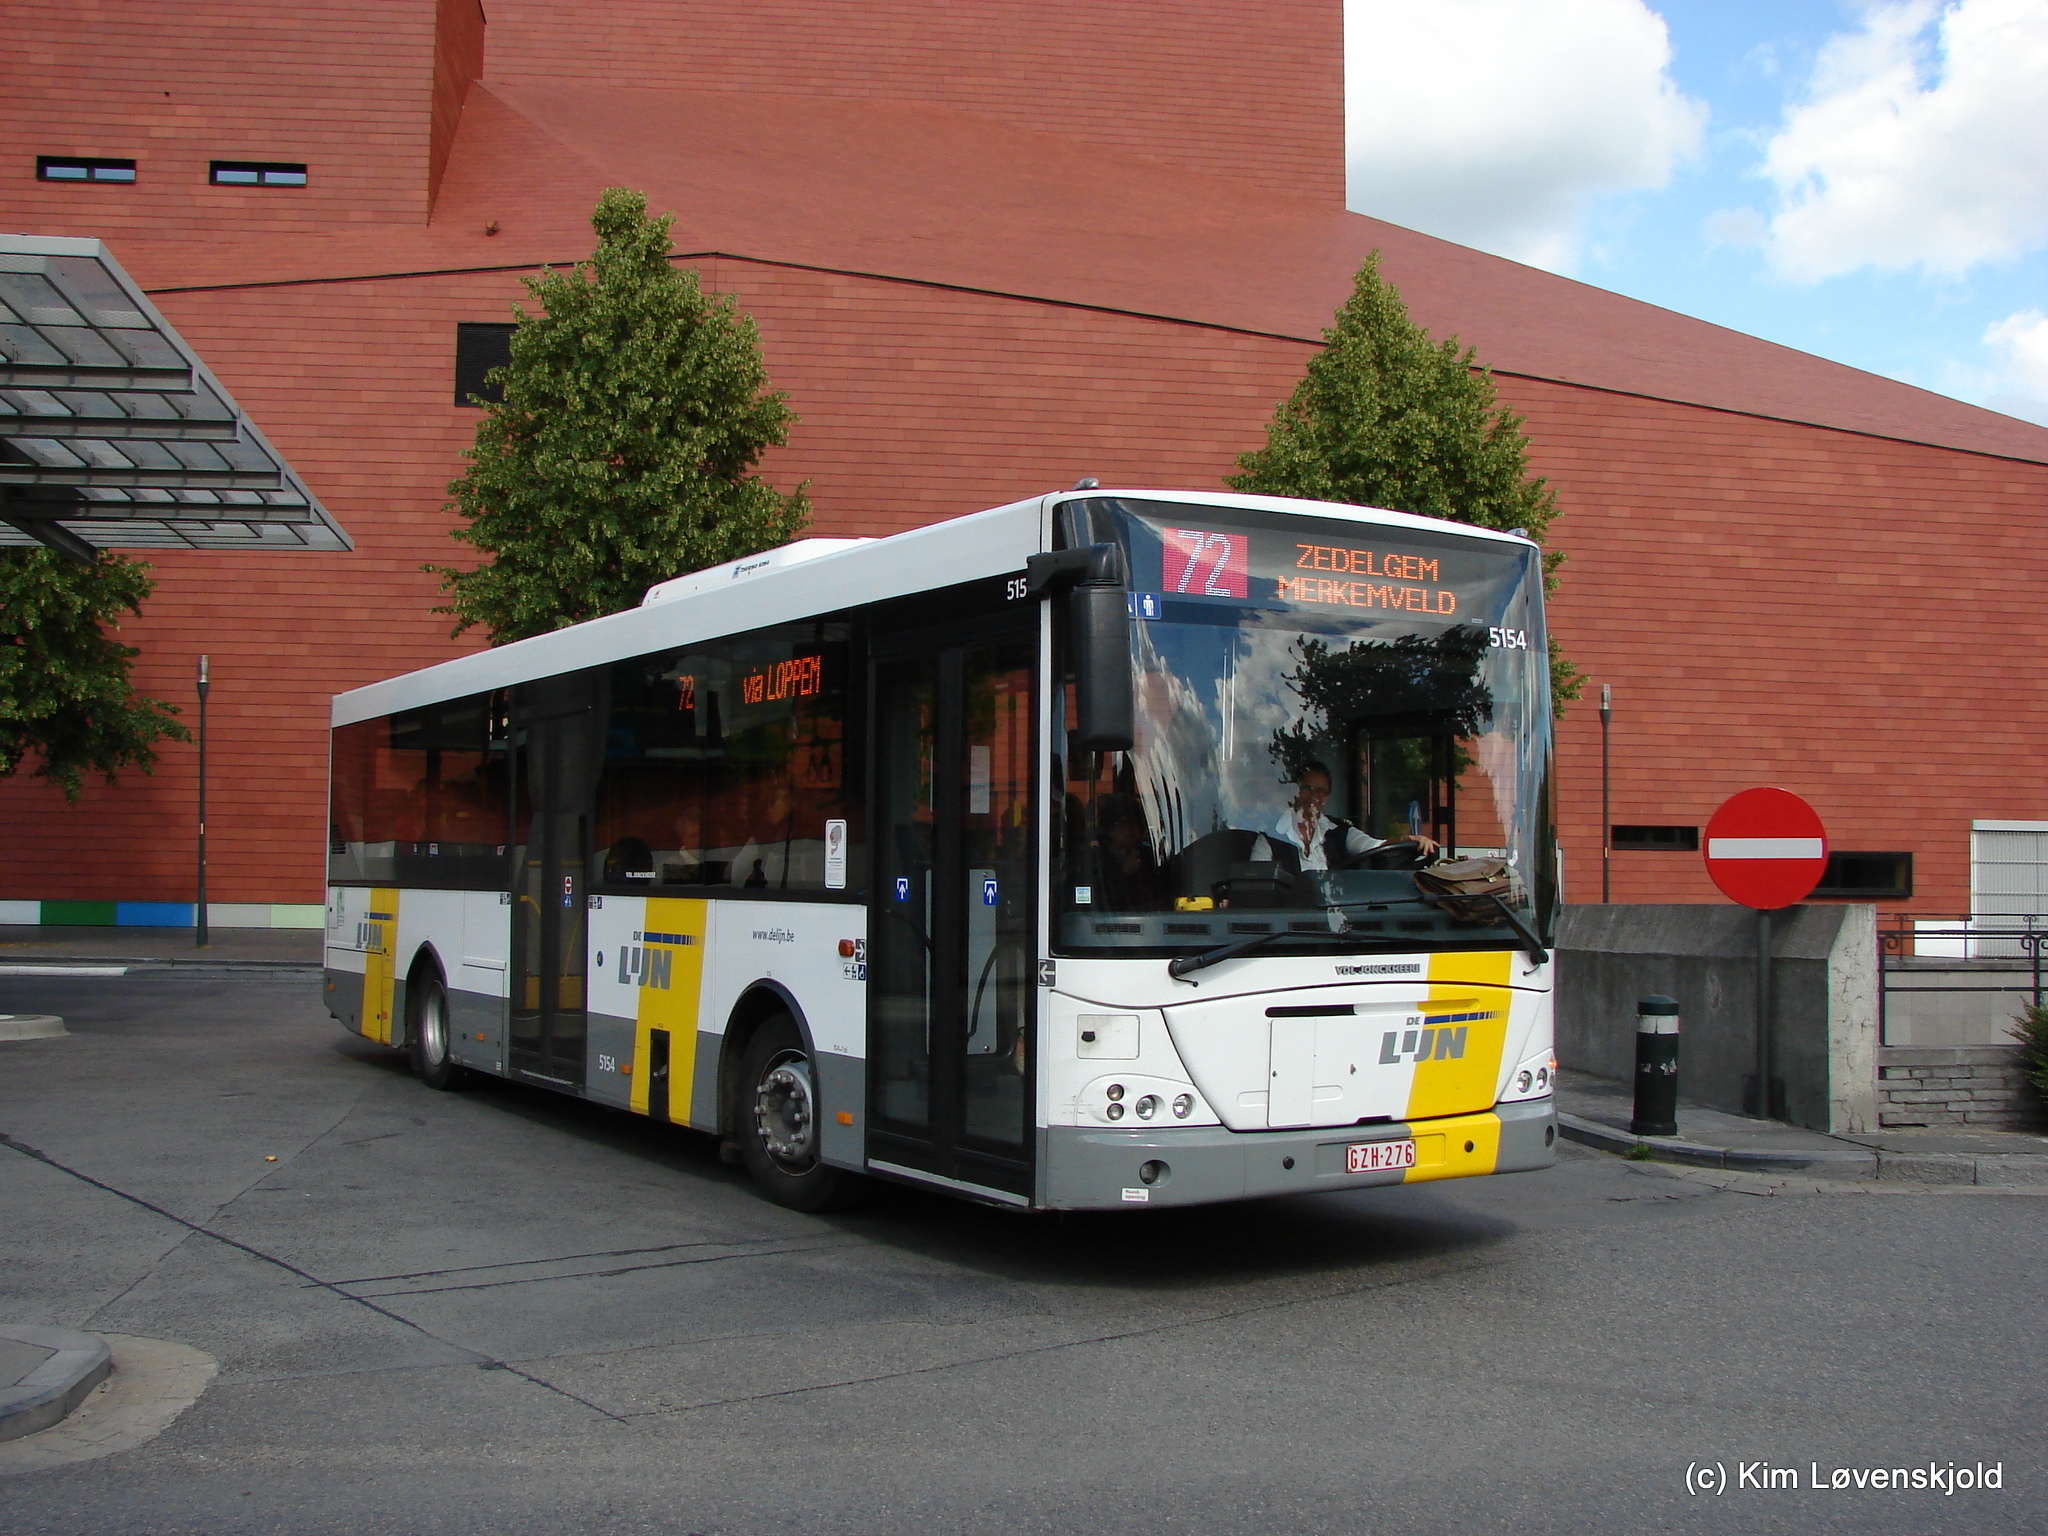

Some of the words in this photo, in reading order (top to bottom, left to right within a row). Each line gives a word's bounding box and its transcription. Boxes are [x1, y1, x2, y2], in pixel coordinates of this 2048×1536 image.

[1177, 528, 1232, 598] 72
[1296, 544, 1439, 582] ZEDELGEM
[1006, 577, 1027, 600] 515
[1277, 575, 1457, 616] MERKEMVELD
[1489, 626, 1527, 650] 5154
[679, 675, 694, 710] 72
[742, 667, 763, 704] via
[766, 655, 821, 701] LOPPEM
[632, 930, 642, 942] DE
[752, 927, 795, 945] www.delijn.be
[618, 945, 672, 990] LIJN
[1405, 1016, 1421, 1026] DE
[1378, 1026, 1468, 1065] LIJN
[598, 1053, 616, 1073] 5154
